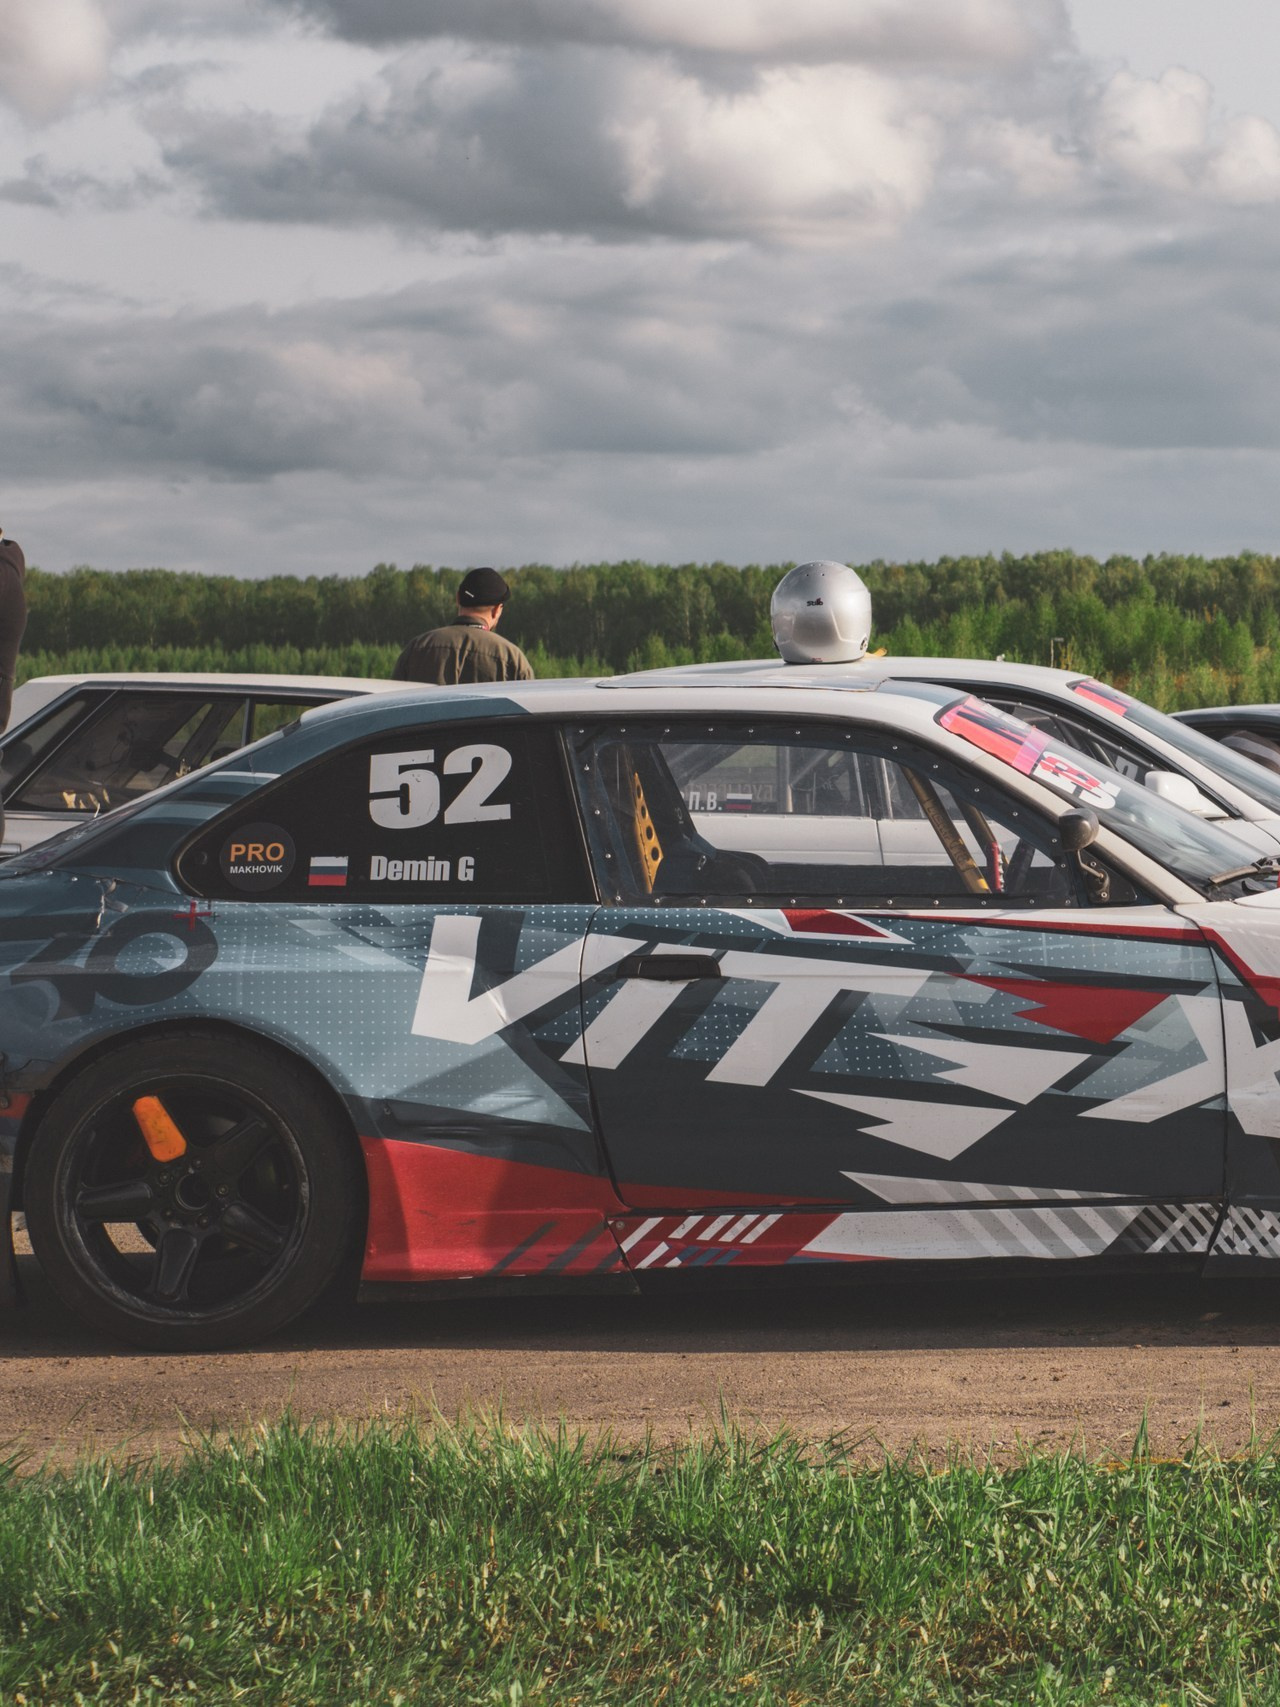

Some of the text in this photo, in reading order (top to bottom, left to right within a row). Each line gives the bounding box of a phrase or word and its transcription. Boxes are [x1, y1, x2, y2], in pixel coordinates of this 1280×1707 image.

[369, 743, 513, 830] 52
[229, 842, 285, 863] PRO
[229, 864, 283, 874] MAKHOVIK
[369, 855, 475, 882] Demin G
